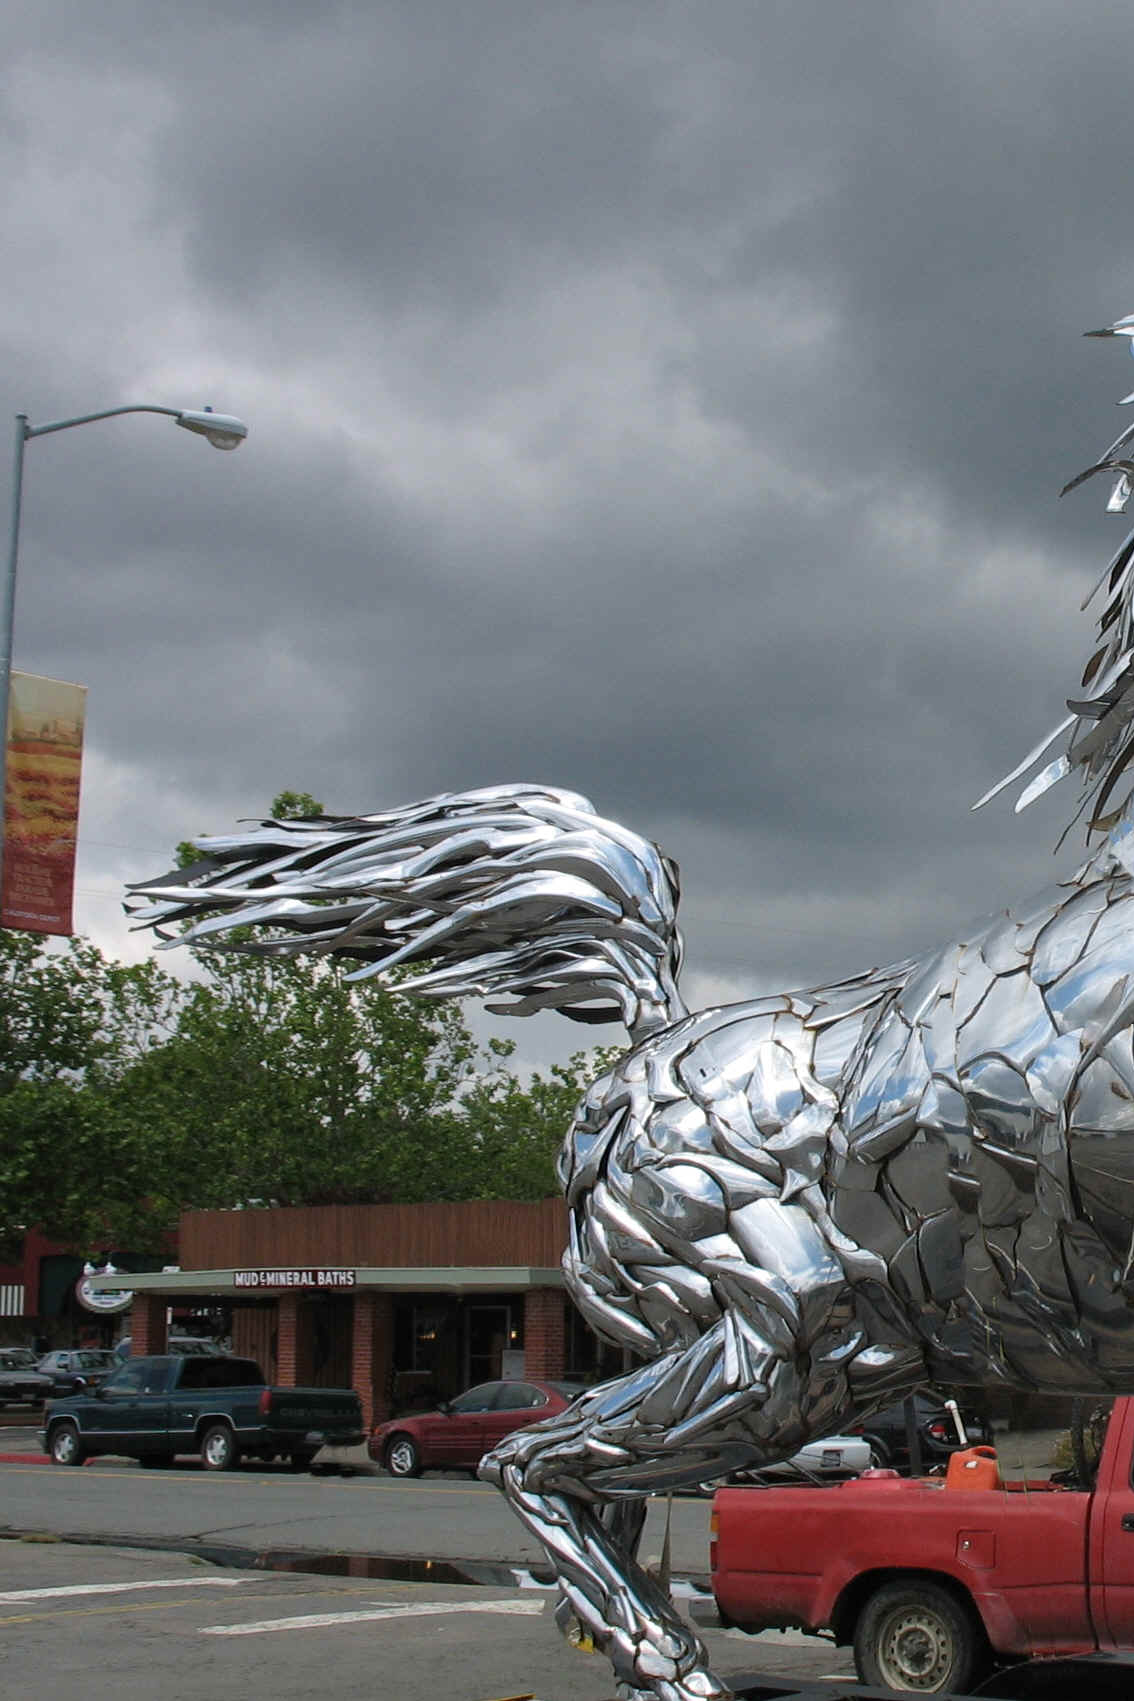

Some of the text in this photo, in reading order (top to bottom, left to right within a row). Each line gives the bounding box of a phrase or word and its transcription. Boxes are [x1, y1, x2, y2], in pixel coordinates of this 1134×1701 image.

[235, 1272, 259, 1286] MUD
[266, 1271, 316, 1286] MINERAL
[317, 1271, 354, 1286] BATHS
